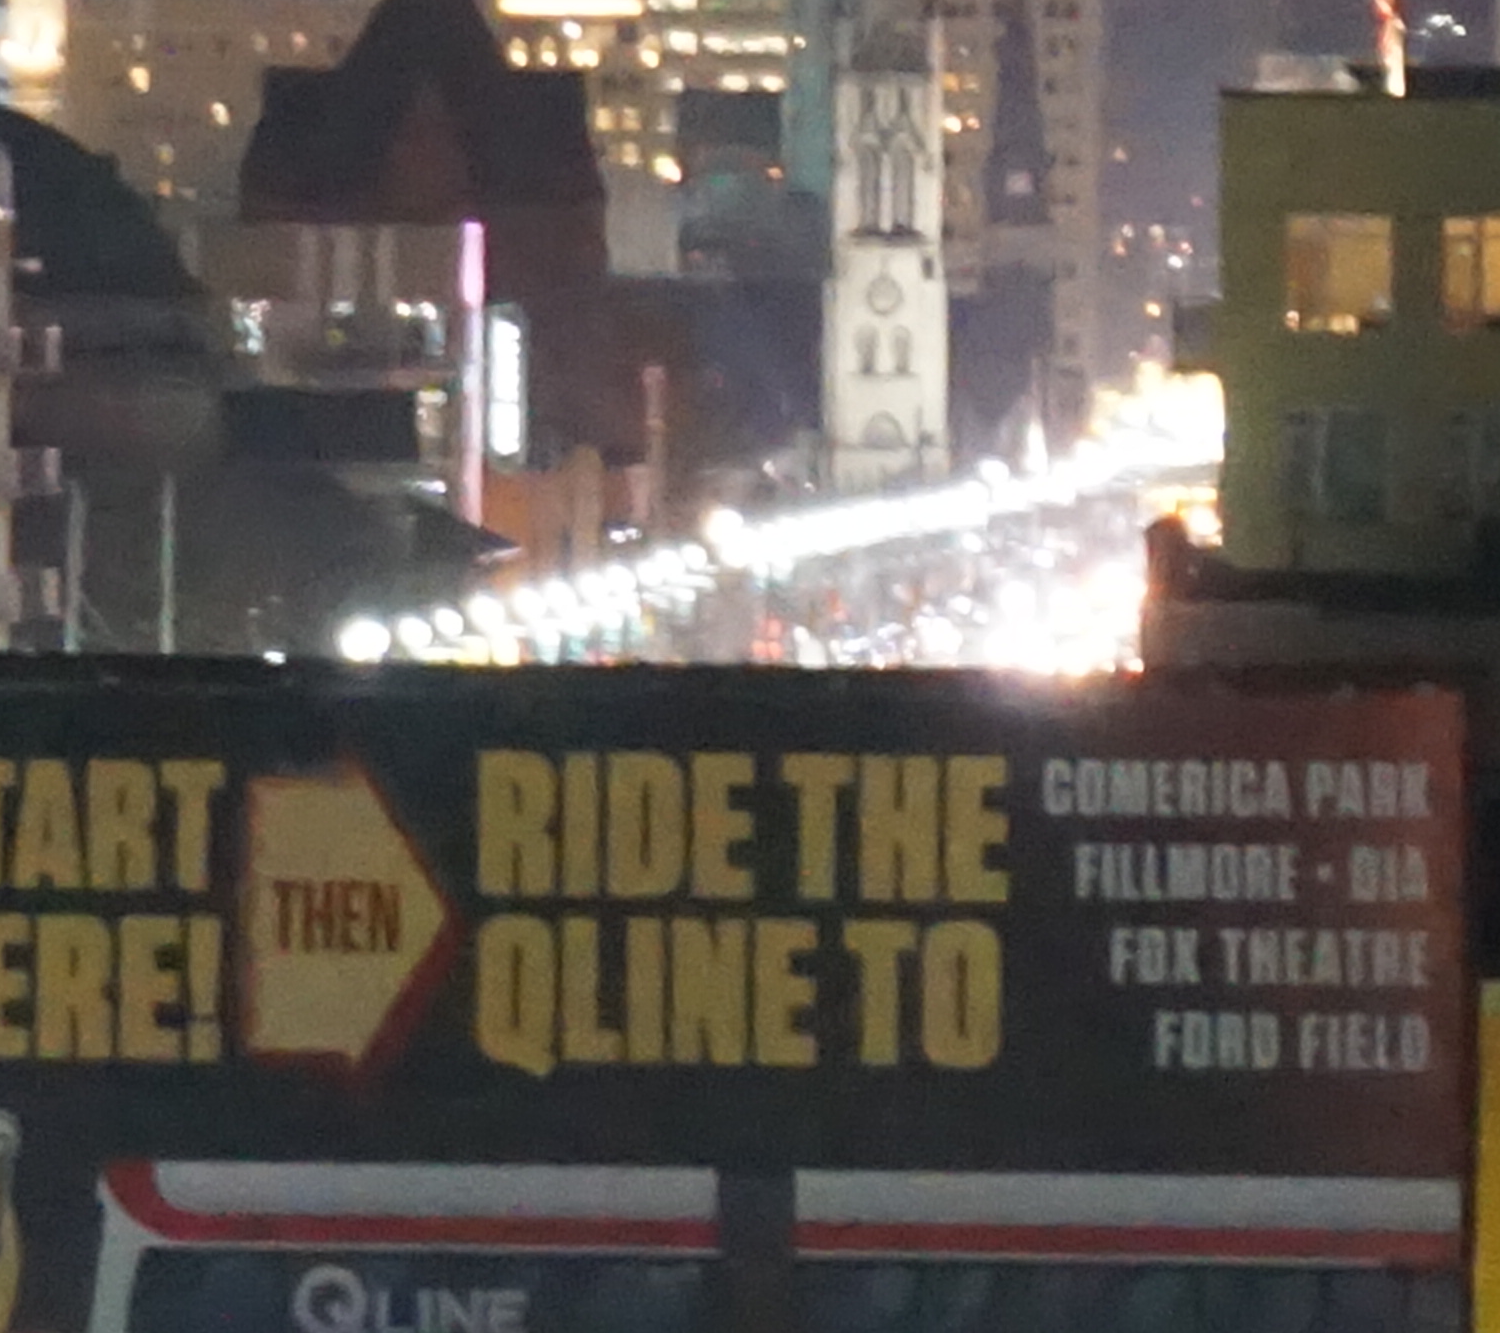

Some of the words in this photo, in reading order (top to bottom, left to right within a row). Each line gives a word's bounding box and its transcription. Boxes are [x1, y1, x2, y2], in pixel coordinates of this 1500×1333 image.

[1041, 758, 1291, 819] COMERICA
[1304, 759, 1430, 819] PARK
[477, 749, 754, 899] RIDE
[781, 752, 1010, 903] THE
[1074, 841, 1297, 901] FILLMORE
[273, 879, 399, 954] THEN
[1110, 928, 1200, 985] FOX
[1219, 928, 1430, 987] THEATRE
[475, 913, 818, 1077] QLINE
[843, 918, 1000, 1070] TO
[1153, 1010, 1281, 1070] FORD
[1301, 1011, 1431, 1072] FIELD
